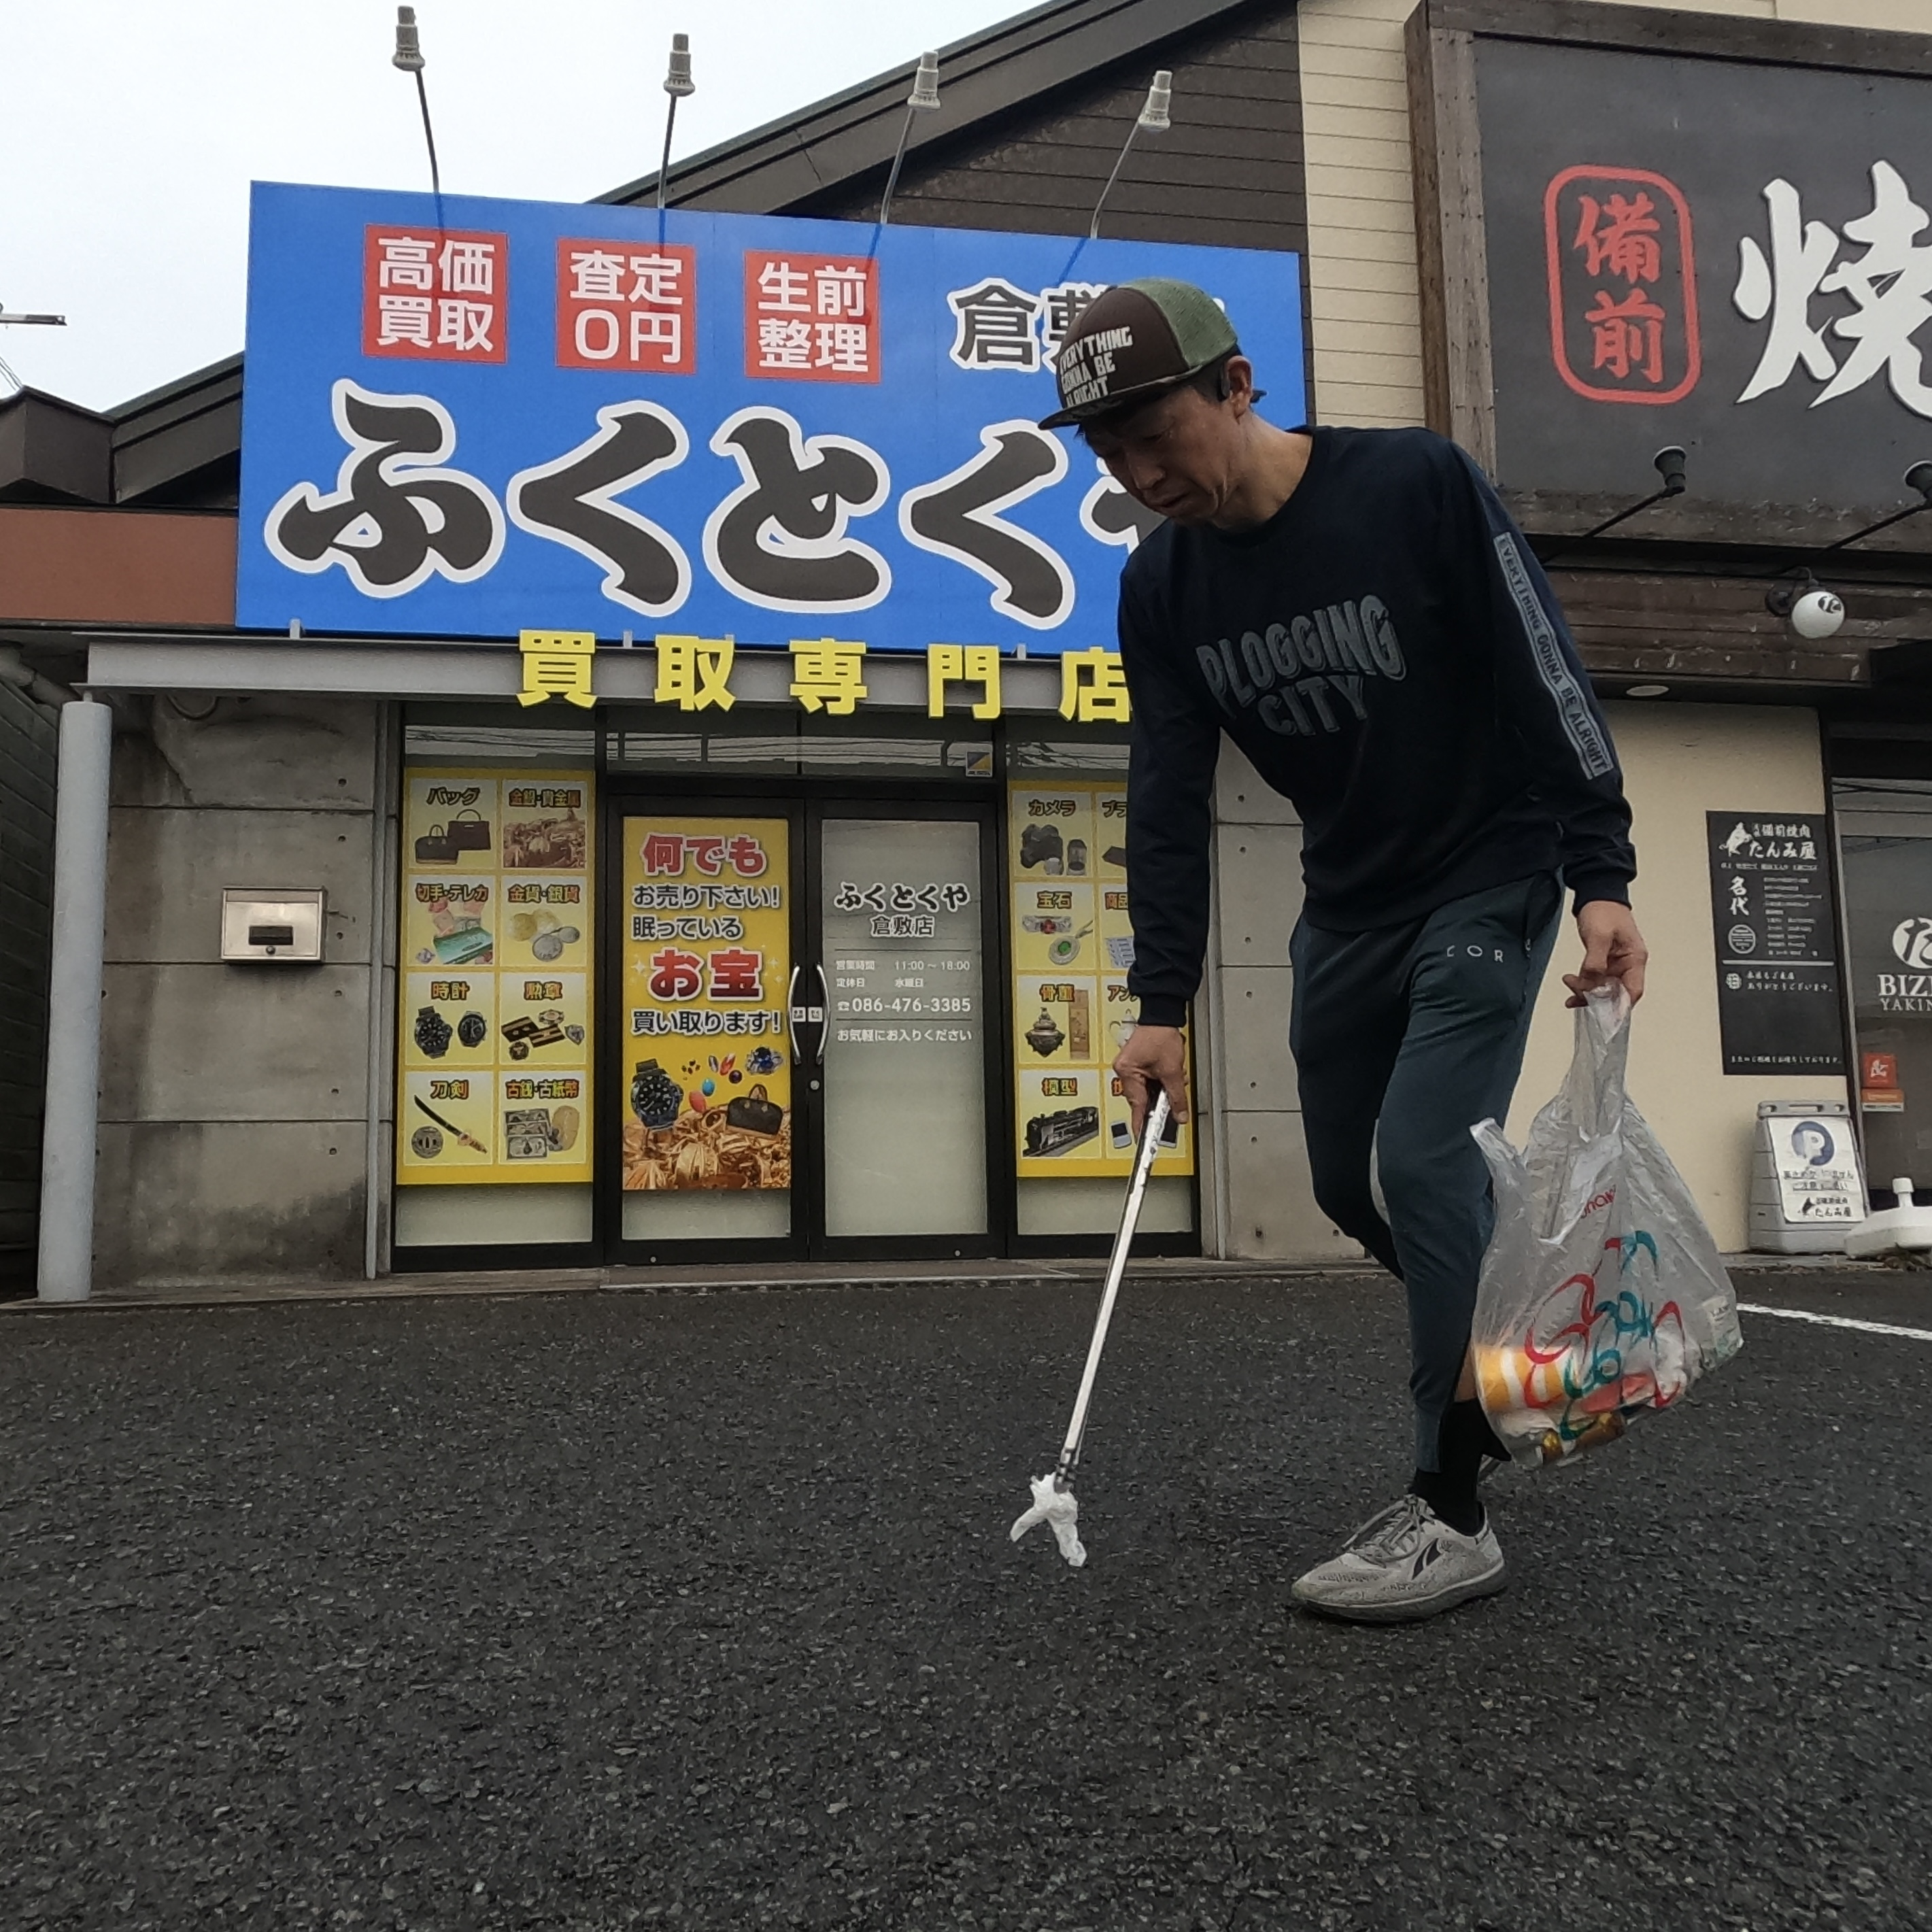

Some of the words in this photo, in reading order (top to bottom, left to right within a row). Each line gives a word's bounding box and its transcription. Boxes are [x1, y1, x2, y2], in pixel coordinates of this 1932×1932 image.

[377, 237, 495, 294] 高価
[569, 250, 682, 305] 査定
[758, 261, 868, 317] 生前
[1573, 192, 1666, 384] 備前
[377, 294, 494, 352] 買取
[758, 317, 868, 373] 整理
[1094, 352, 1117, 377] BE
[1195, 594, 1407, 719] PLOGGING
[516, 630, 1130, 723] 買取専門店
[1258, 675, 1368, 736] CITY
[426, 786, 481, 806] バッグ
[1028, 799, 1076, 817] カメラ
[641, 832, 767, 877] 何でも
[1748, 841, 1818, 860] たんみ屋
[415, 882, 490, 903] 切手・テレカ
[834, 881, 970, 913] ふくとくや
[1036, 891, 1072, 909] 宝石
[631, 914, 743, 940] 眠っている
[870, 915, 935, 938] 倉敷店
[648, 946, 764, 1001] お宝
[894, 960, 925, 971] 11:00
[430, 981, 471, 1000] 時計
[1878, 974, 1932, 997] BIZ
[851, 997, 972, 1013] 086-476-3385
[430, 1079, 470, 1099] 刀剣
